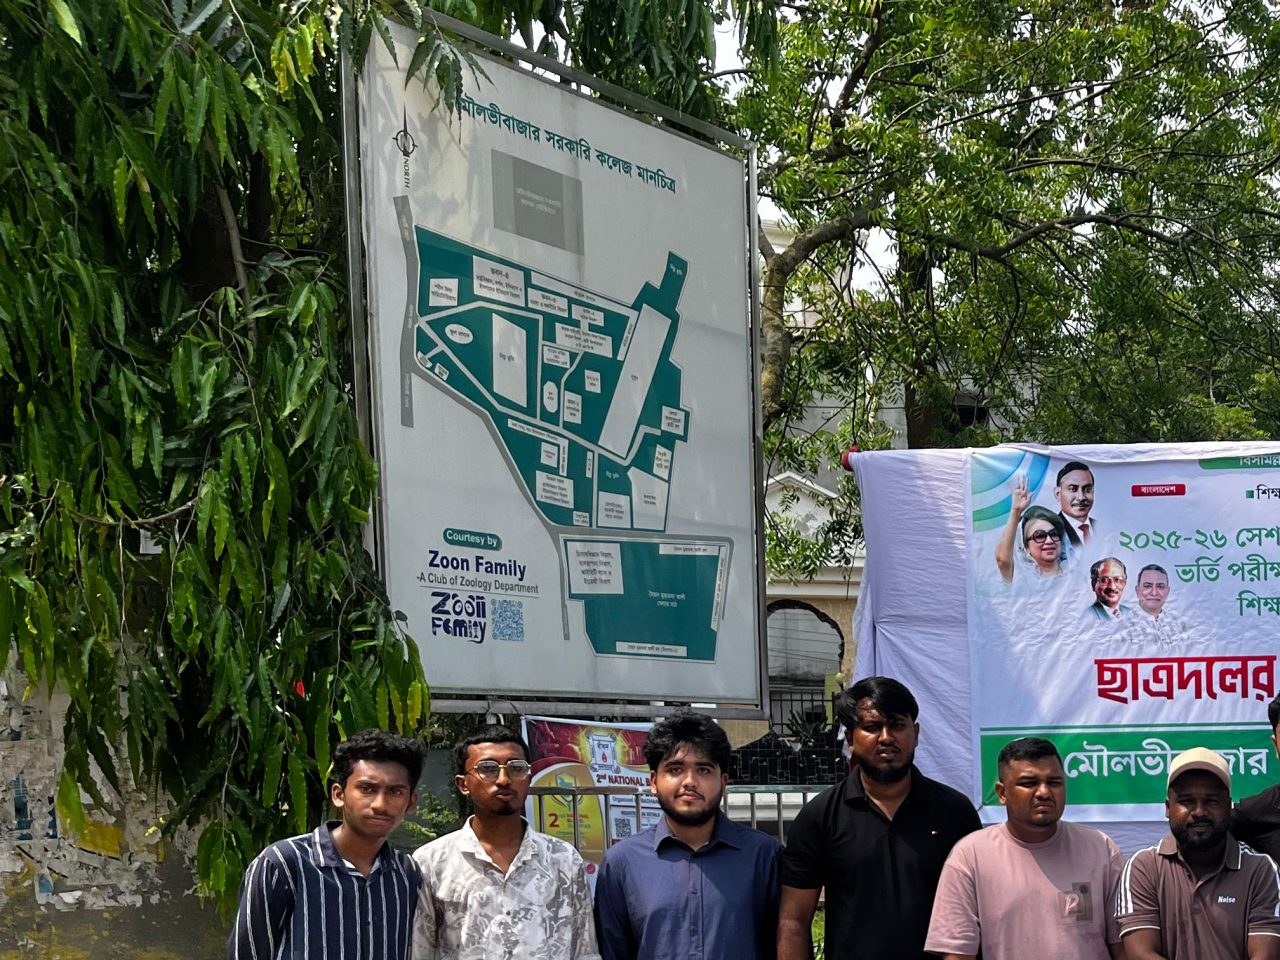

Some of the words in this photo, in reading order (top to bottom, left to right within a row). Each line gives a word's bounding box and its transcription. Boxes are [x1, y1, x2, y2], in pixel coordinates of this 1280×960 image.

[457, 93, 540, 143] মৌলভীবাজার
[545, 129, 592, 161] সরকারি
[596, 149, 632, 178] কলেজ
[637, 164, 676, 194] মানচিত্র
[401, 157, 411, 188] NORTH
[1140, 485, 1176, 494] বাংলাদেশ
[446, 530, 485, 545] Courtesy
[487, 535, 498, 548] by
[1119, 529, 1228, 551] ২০২৫-২৬
[428, 550, 470, 571] Zoon
[475, 555, 526, 581] Family
[1174, 555, 1224, 583] ভর্তি
[427, 573, 447, 585] Club
[449, 575, 458, 585] of
[460, 576, 492, 591] Zoology
[494, 580, 539, 593] Department
[1094, 655, 1277, 704] ছাত্রদলের
[1063, 737, 1269, 778] মৌলভীজার
[596, 774, 607, 783] 2nd
[608, 775, 644, 786] NATIONAL
